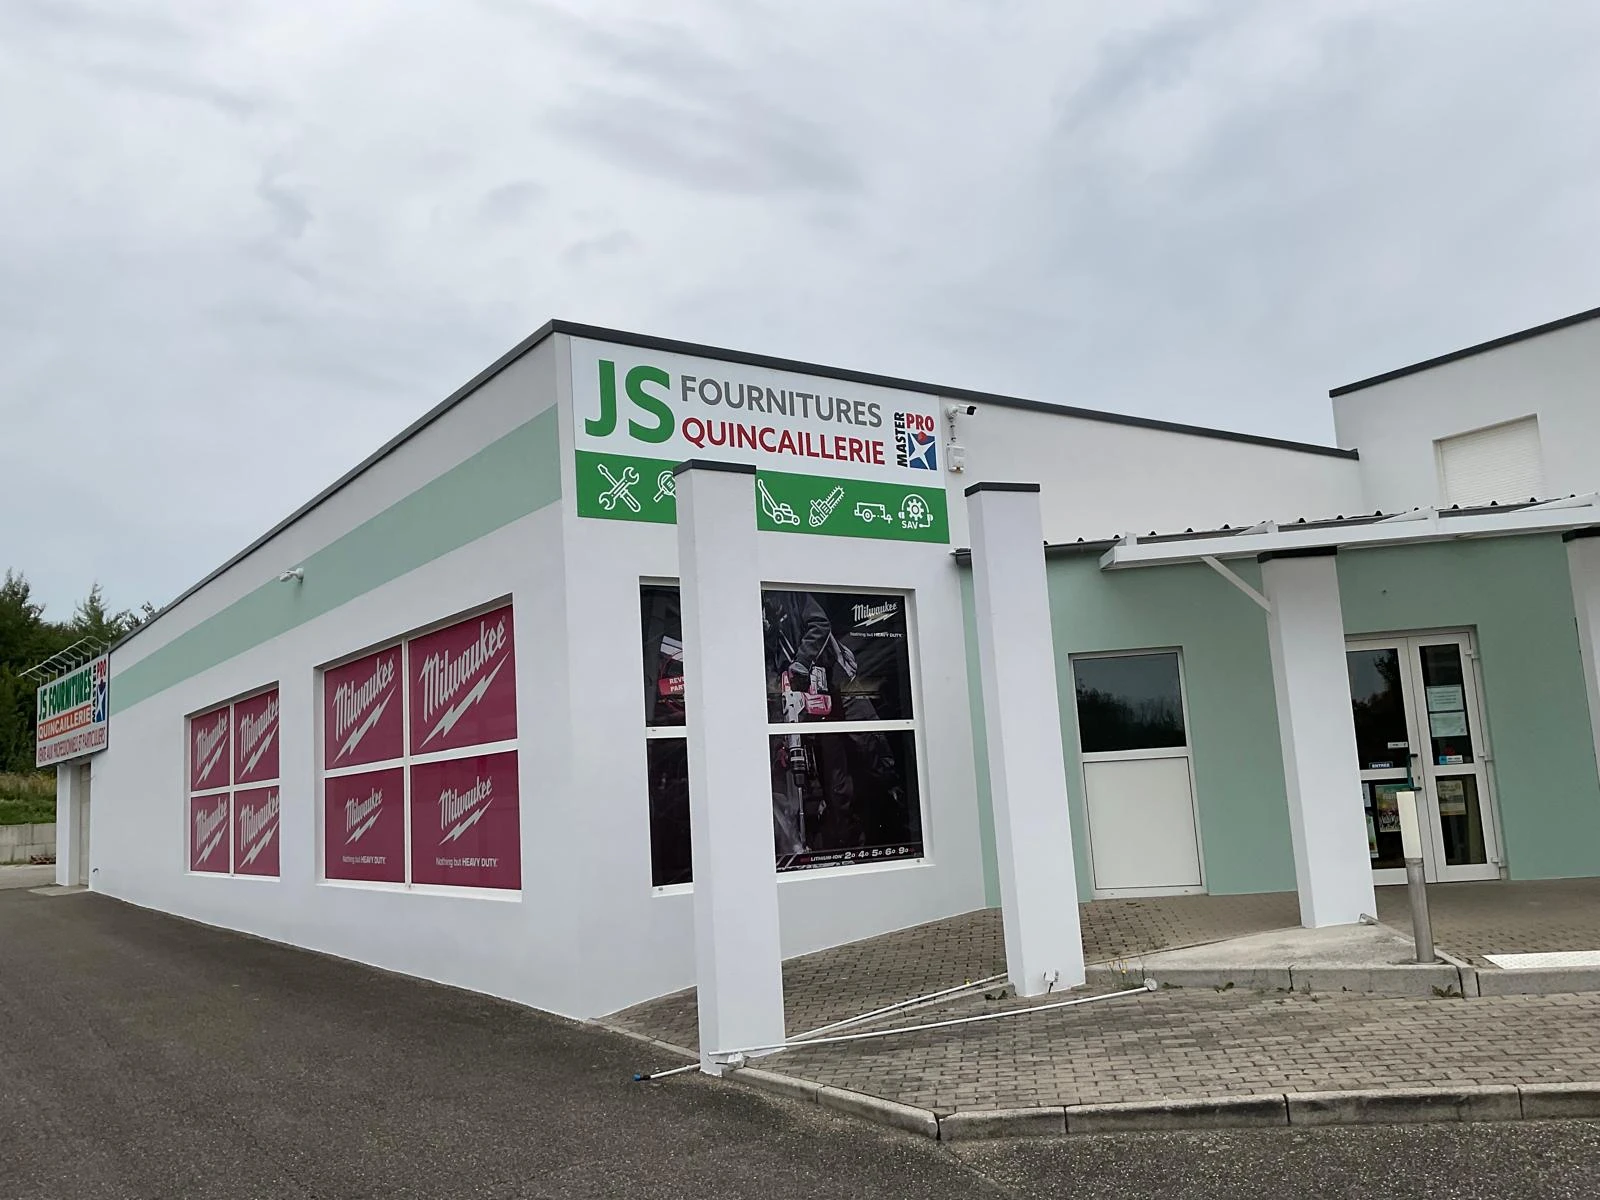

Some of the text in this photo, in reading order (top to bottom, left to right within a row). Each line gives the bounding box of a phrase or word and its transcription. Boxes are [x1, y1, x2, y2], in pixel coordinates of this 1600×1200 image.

[584, 359, 675, 444] JS
[680, 375, 883, 429] FOURNITURES
[906, 413, 935, 432] PRO
[681, 416, 886, 466] QUINCAILLERIE
[894, 412, 908, 468] MASTER
[901, 520, 919, 529] SAV
[851, 601, 898, 622] Milwaukee
[332, 656, 395, 742] Milwaukee
[419, 619, 507, 724] Milwaukee
[38, 688, 48, 721] JS
[39, 706, 92, 739] QUINCAILLERIE
[239, 696, 279, 763] Milwaukee
[195, 712, 228, 772] Milwaukee
[195, 796, 228, 852] Milwaukee
[239, 789, 279, 852] Milwaukee
[344, 788, 383, 833] Milwaukee
[438, 775, 493, 831] Milwaukee
[436, 857, 453, 868] Nothing
[462, 858, 480, 867] HEAVY
